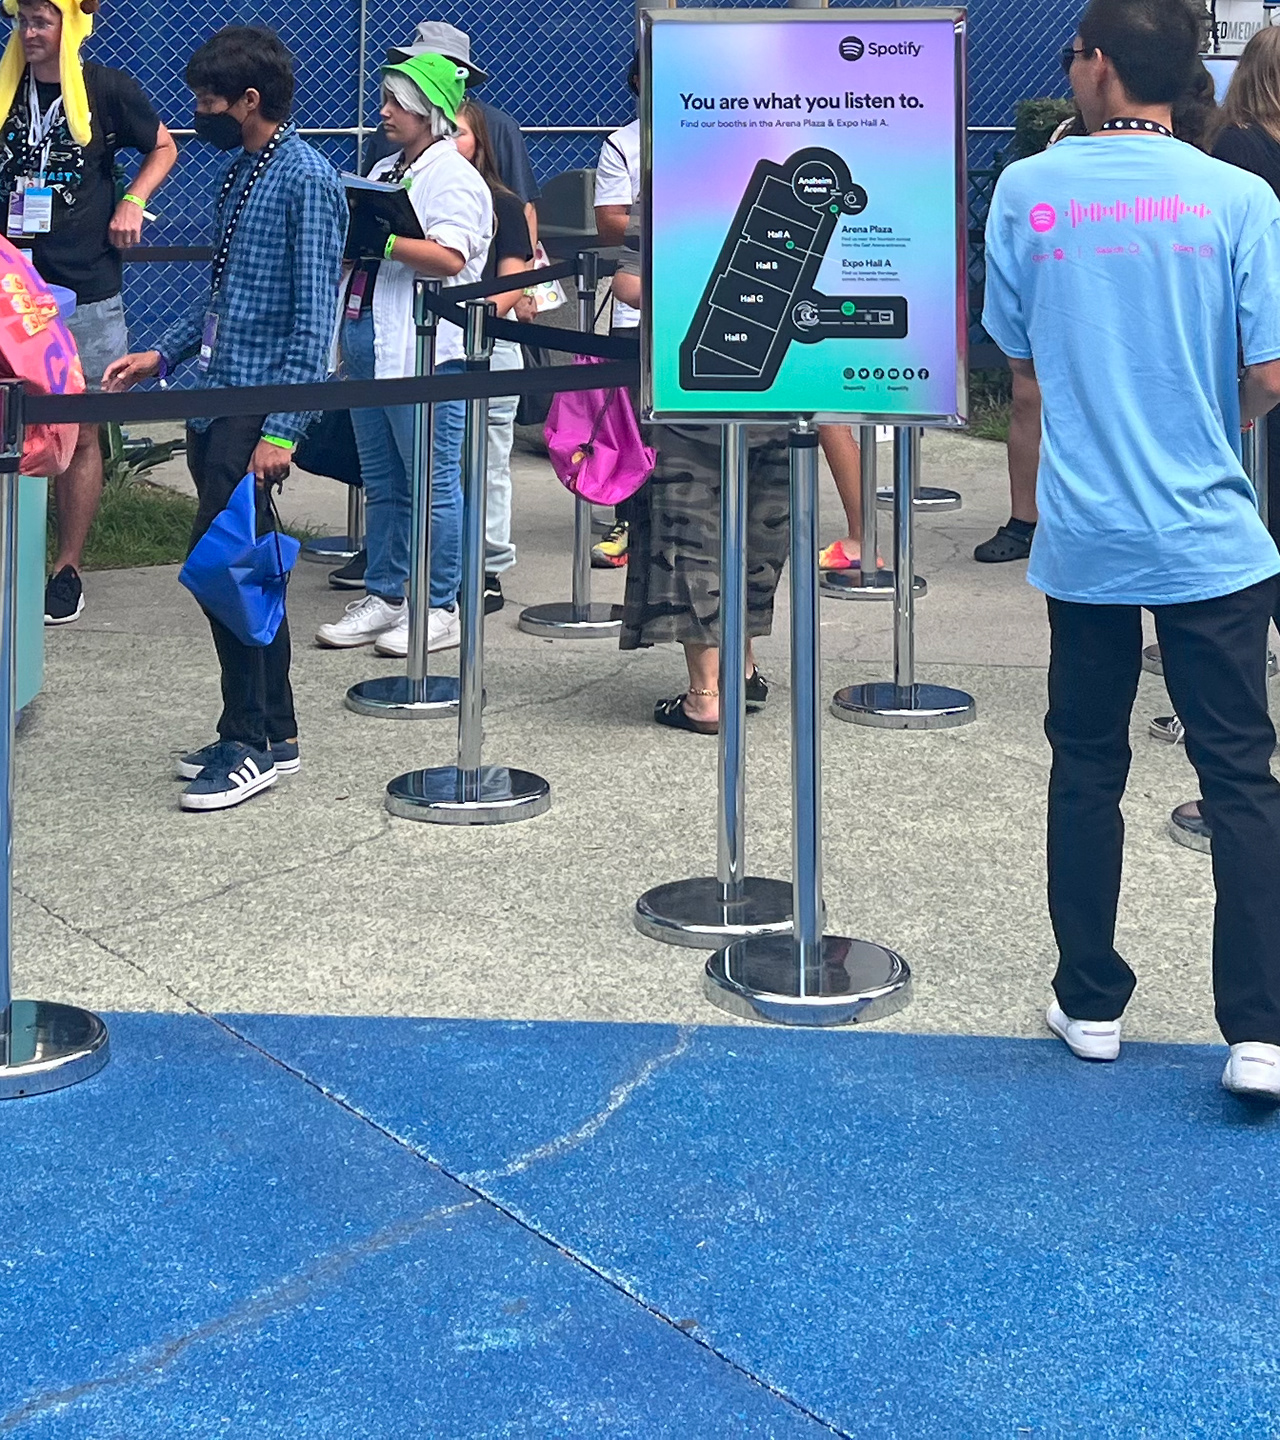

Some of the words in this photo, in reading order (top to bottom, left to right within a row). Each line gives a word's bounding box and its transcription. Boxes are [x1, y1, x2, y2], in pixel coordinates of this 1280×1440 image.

[868, 41, 922, 57] Spotify
[680, 93, 715, 110] You
[719, 97, 749, 110] are
[753, 92, 802, 109] what
[805, 97, 841, 113] you
[845, 91, 895, 109] listen
[899, 93, 924, 109] to.
[680, 119, 699, 128] Find
[717, 119, 747, 128] booths
[749, 119, 757, 127] in
[759, 119, 773, 127] the
[775, 119, 801, 128] Arena
[803, 119, 826, 127] Plaza
[827, 119, 835, 127] &
[837, 119, 859, 128] Expo
[861, 119, 877, 127] Hall
[798, 177, 832, 185] Anaheim
[803, 185, 827, 193] Arena
[842, 225, 868, 233] Arena
[869, 225, 893, 233] Plaza
[767, 230, 783, 239] Hall
[783, 231, 791, 239] A
[756, 261, 771, 269] Hall
[842, 259, 864, 268] Expo
[866, 259, 882, 267] Hall
[884, 259, 891, 267] A
[740, 295, 755, 303] Hall
[756, 295, 764, 303] C
[724, 333, 739, 342] Hall
[740, 334, 748, 342] D
